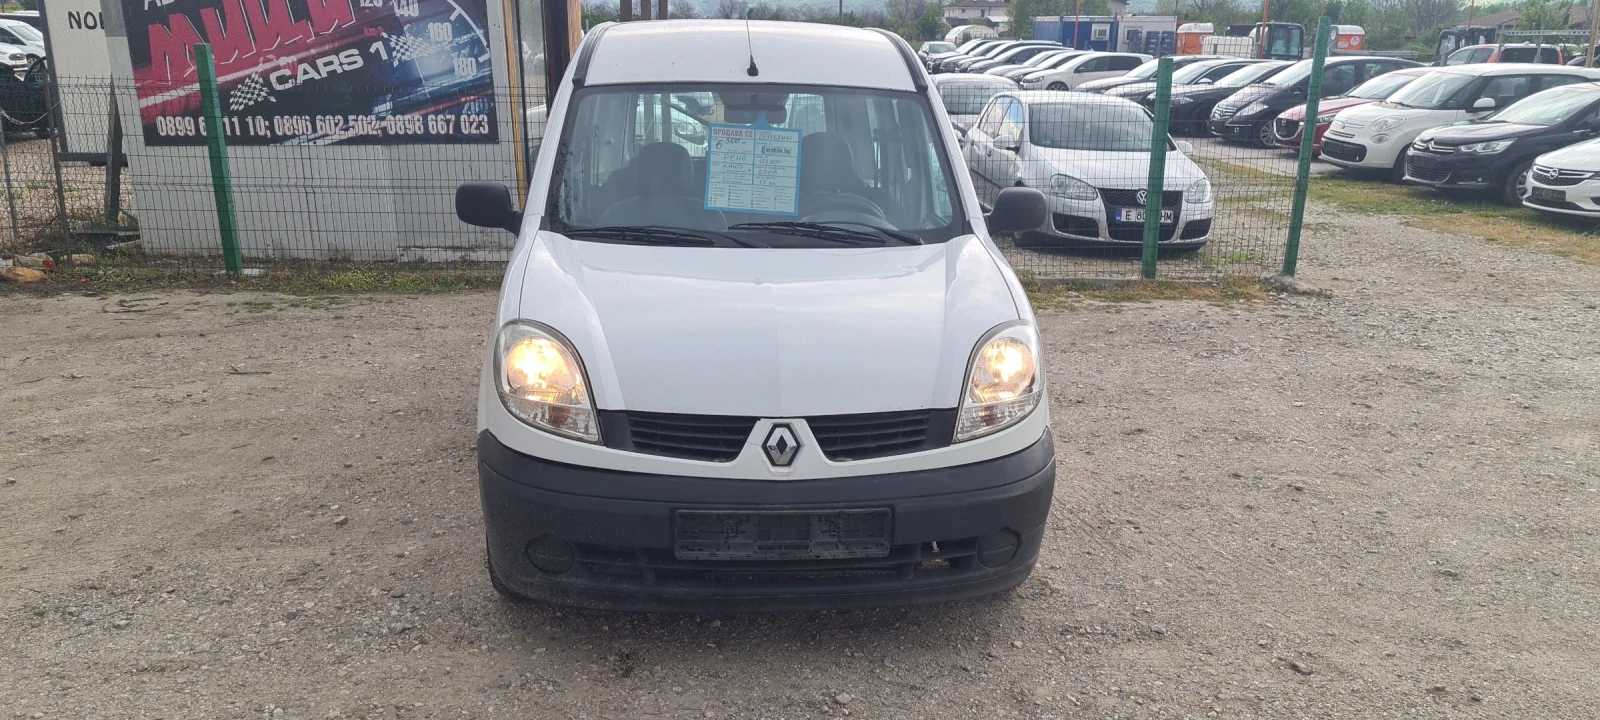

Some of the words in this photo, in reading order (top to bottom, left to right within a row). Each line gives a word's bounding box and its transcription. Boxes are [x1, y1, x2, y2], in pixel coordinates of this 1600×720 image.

[427, 22, 453, 41] 160
[269, 48, 364, 92] CARS
[369, 40, 389, 61] 1
[452, 57, 477, 76] 180
[156, 116, 196, 137] 0899
[274, 115, 313, 137] 0896
[316, 114, 345, 136] 602
[386, 114, 425, 136] 0898
[427, 114, 456, 136] 667
[460, 114, 490, 136] 023
[713, 128, 744, 138] ПРОДАВА
[745, 130, 754, 138] СЕ
[715, 139, 724, 149] 6
[1125, 210, 1132, 220] E
